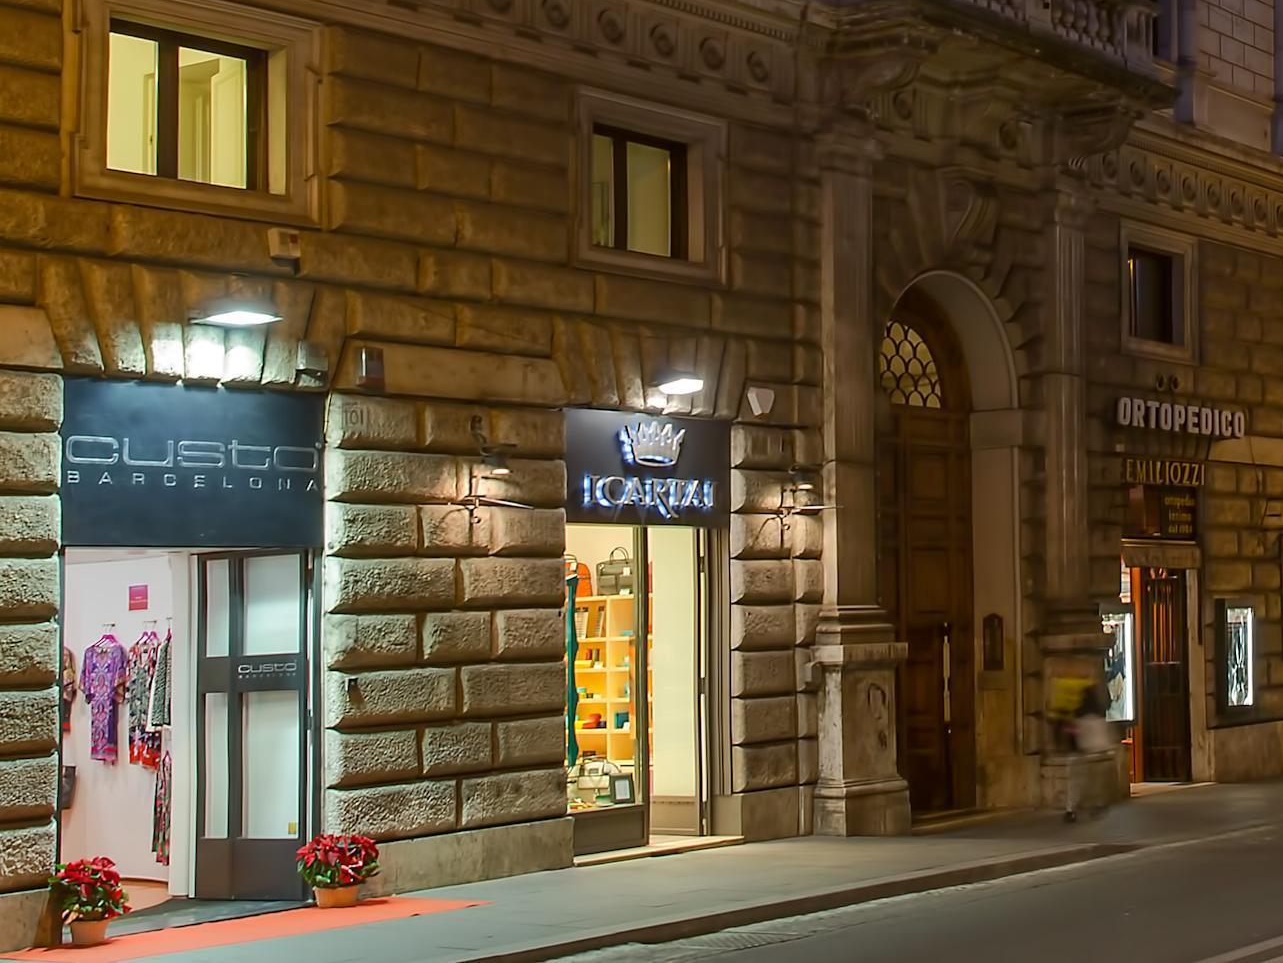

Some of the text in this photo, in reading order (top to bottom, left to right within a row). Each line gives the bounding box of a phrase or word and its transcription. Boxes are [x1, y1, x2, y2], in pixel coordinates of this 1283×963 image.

[1117, 397, 1245, 437] ORTOPEDICO
[66, 470, 319, 491] BARCELONA
[1126, 459, 1205, 486] EMILIOZZI
